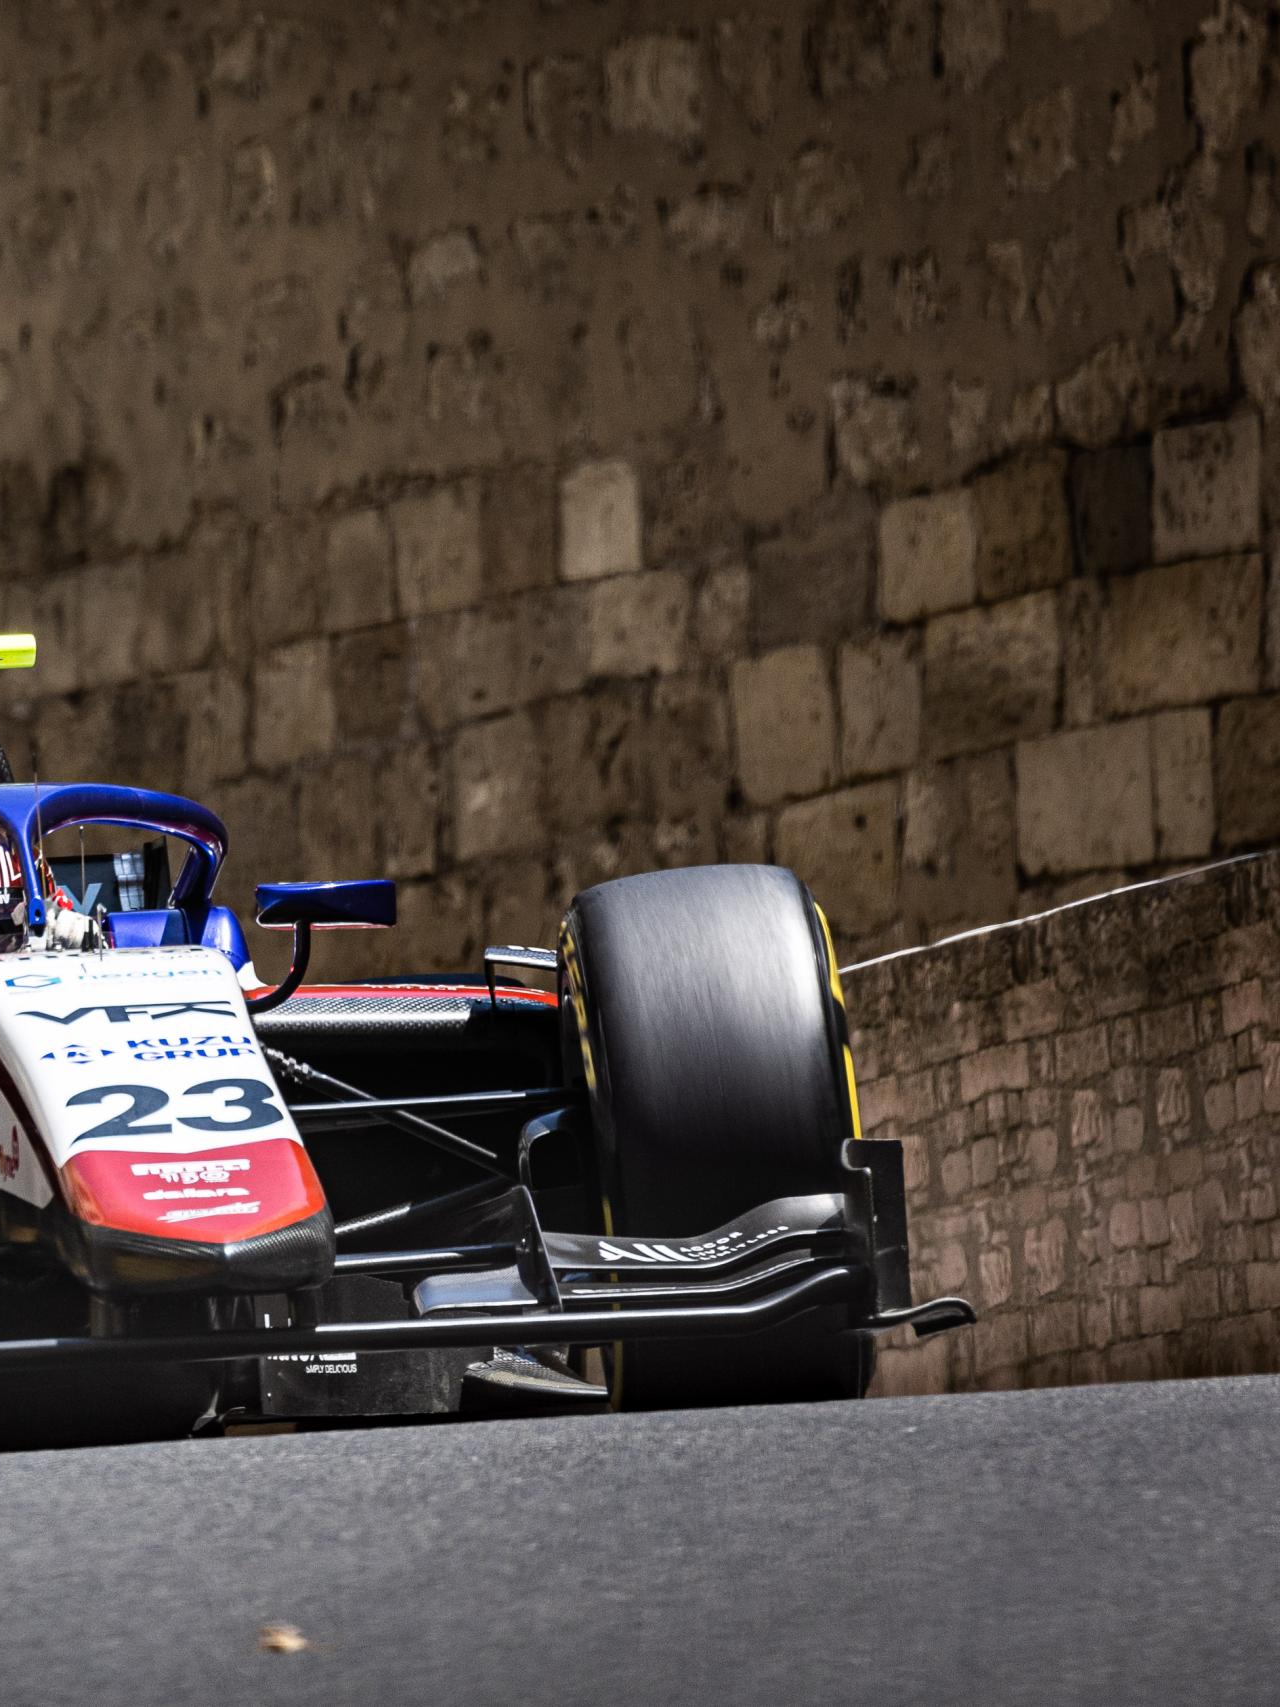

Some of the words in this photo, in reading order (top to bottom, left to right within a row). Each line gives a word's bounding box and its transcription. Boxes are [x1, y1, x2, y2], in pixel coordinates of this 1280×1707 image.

[127, 1036, 252, 1049] KUZU
[134, 1048, 257, 1062] GRUP
[66, 1078, 285, 1149] 23
